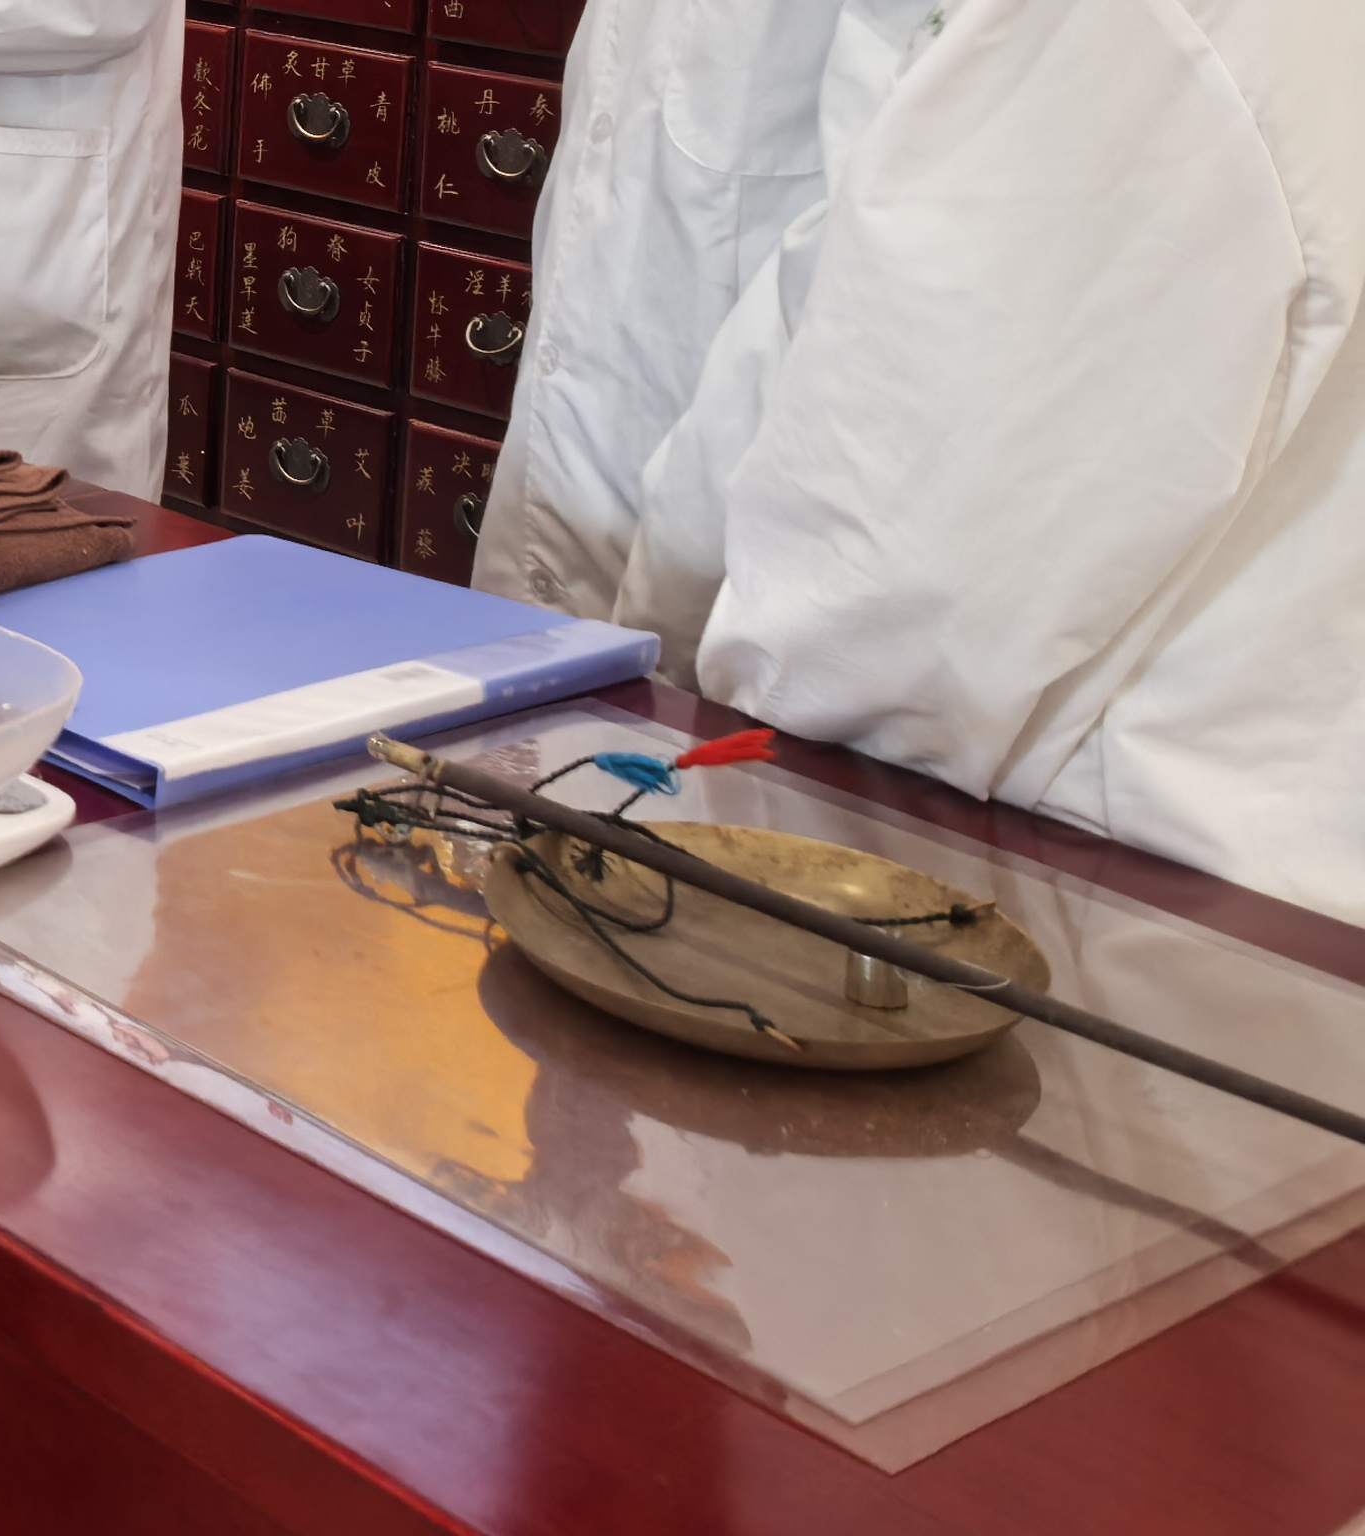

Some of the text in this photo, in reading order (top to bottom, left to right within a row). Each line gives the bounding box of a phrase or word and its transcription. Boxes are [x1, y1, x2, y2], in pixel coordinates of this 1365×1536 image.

[282, 47, 359, 83] 炙甘草
[474, 86, 558, 126] 丹参
[250, 72, 273, 164] 佛手
[365, 90, 392, 188] 青皮
[434, 107, 461, 200] 桃仁
[185, 231, 205, 321] 巴戟天
[277, 223, 350, 263] 狗脊
[352, 265, 380, 363] 女贞子
[423, 289, 450, 384] 怀牛膝
[231, 415, 257, 501] 炮姜
[271, 397, 337, 438] 茜草
[345, 447, 372, 541] 艾叶
